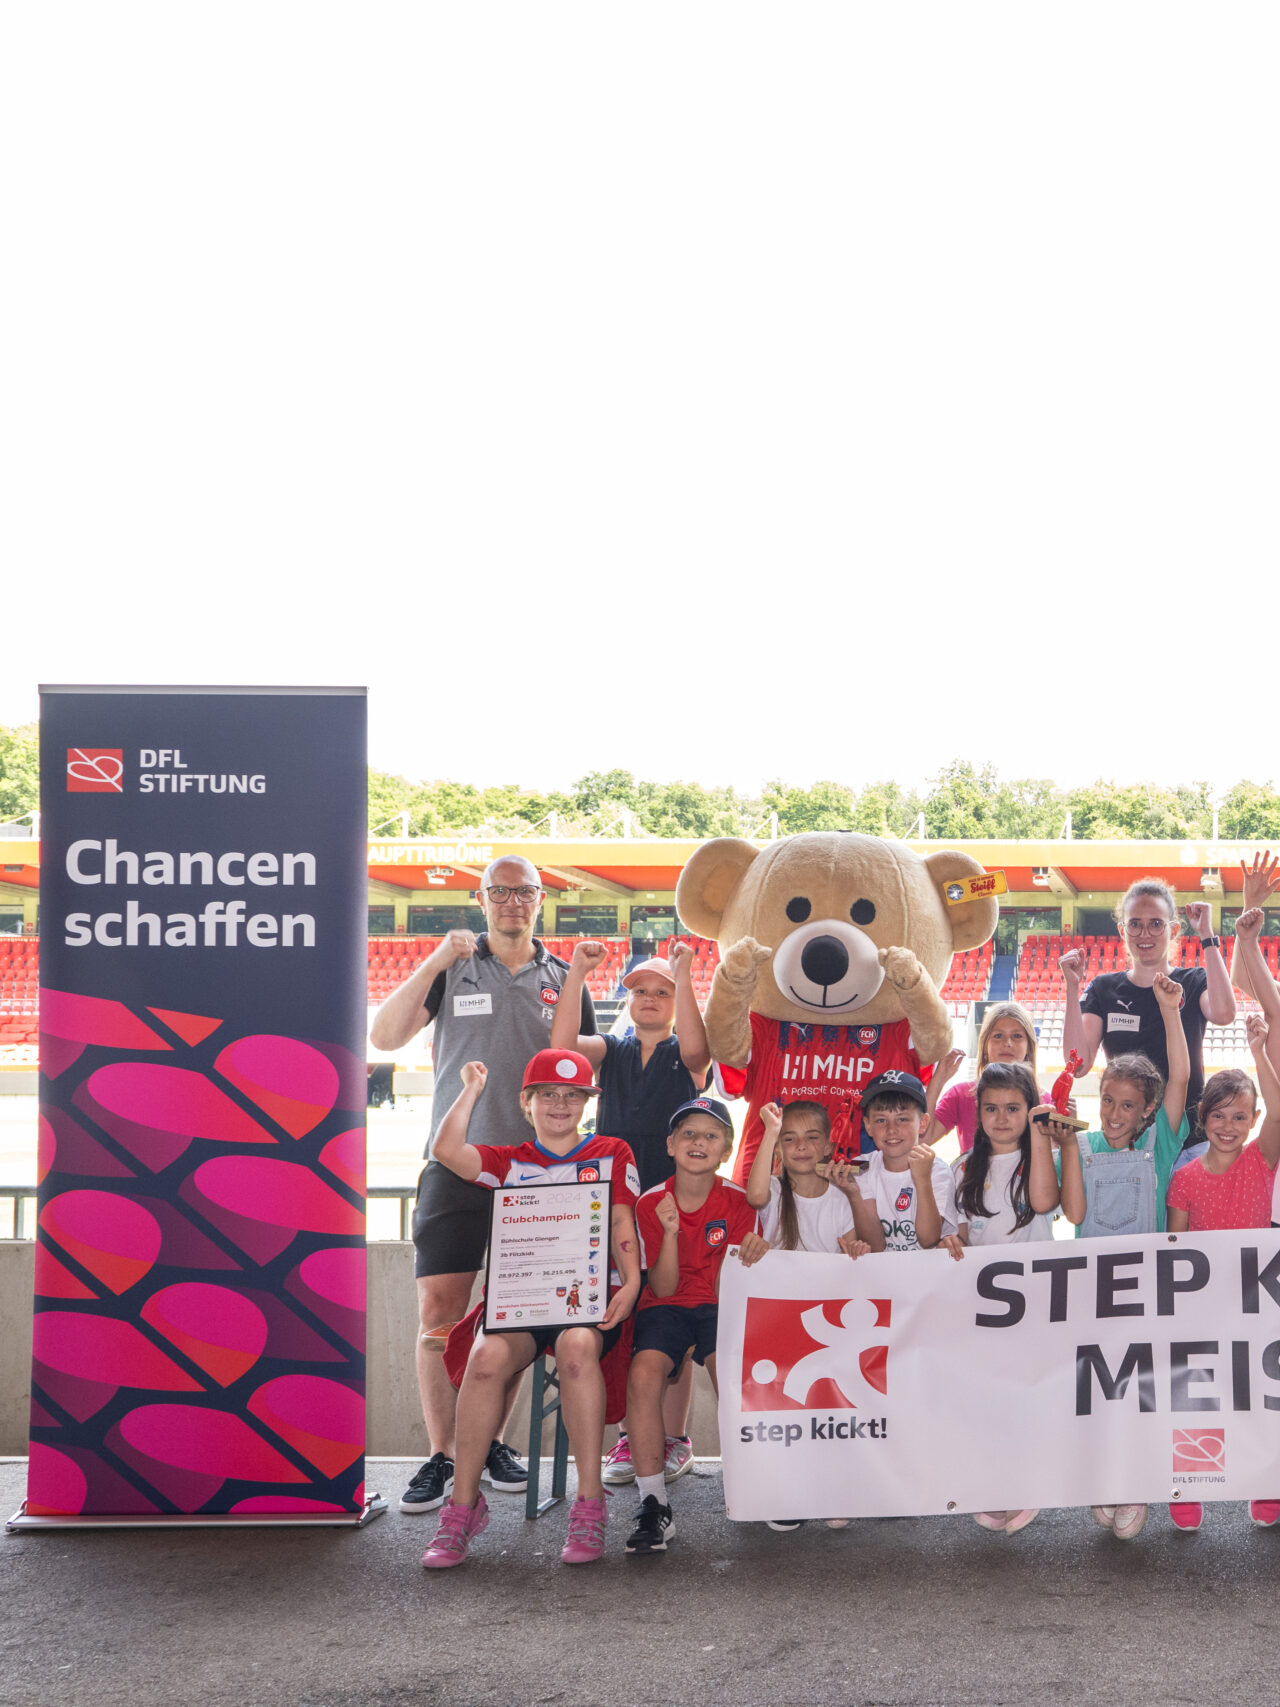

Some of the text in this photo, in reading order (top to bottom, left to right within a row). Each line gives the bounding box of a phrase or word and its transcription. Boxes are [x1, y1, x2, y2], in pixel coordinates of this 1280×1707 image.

[139, 749, 187, 768] DFL
[139, 774, 266, 793] STIFTUNG
[368, 841, 494, 863] AUPTTRIBÜNE
[65, 838, 316, 886] Chancen
[970, 878, 996, 893] Steiff
[64, 900, 316, 948] schaffen
[543, 991, 556, 1001] FCH
[541, 1007, 553, 1020] FS
[861, 1030, 874, 1038] FCH
[812, 1054, 874, 1082] MHP
[781, 1087, 788, 1096] A
[791, 1085, 828, 1096] PORSCHE
[581, 1172, 596, 1181] FCH
[547, 1192, 582, 1204] 2024
[502, 1213, 581, 1225] Clubchampion
[709, 1232, 724, 1242] FCH
[974, 1248, 1211, 1329] STEP
[741, 1416, 888, 1448] step kickt!
[1172, 1475, 1226, 1484] DFL STIFTUNG
